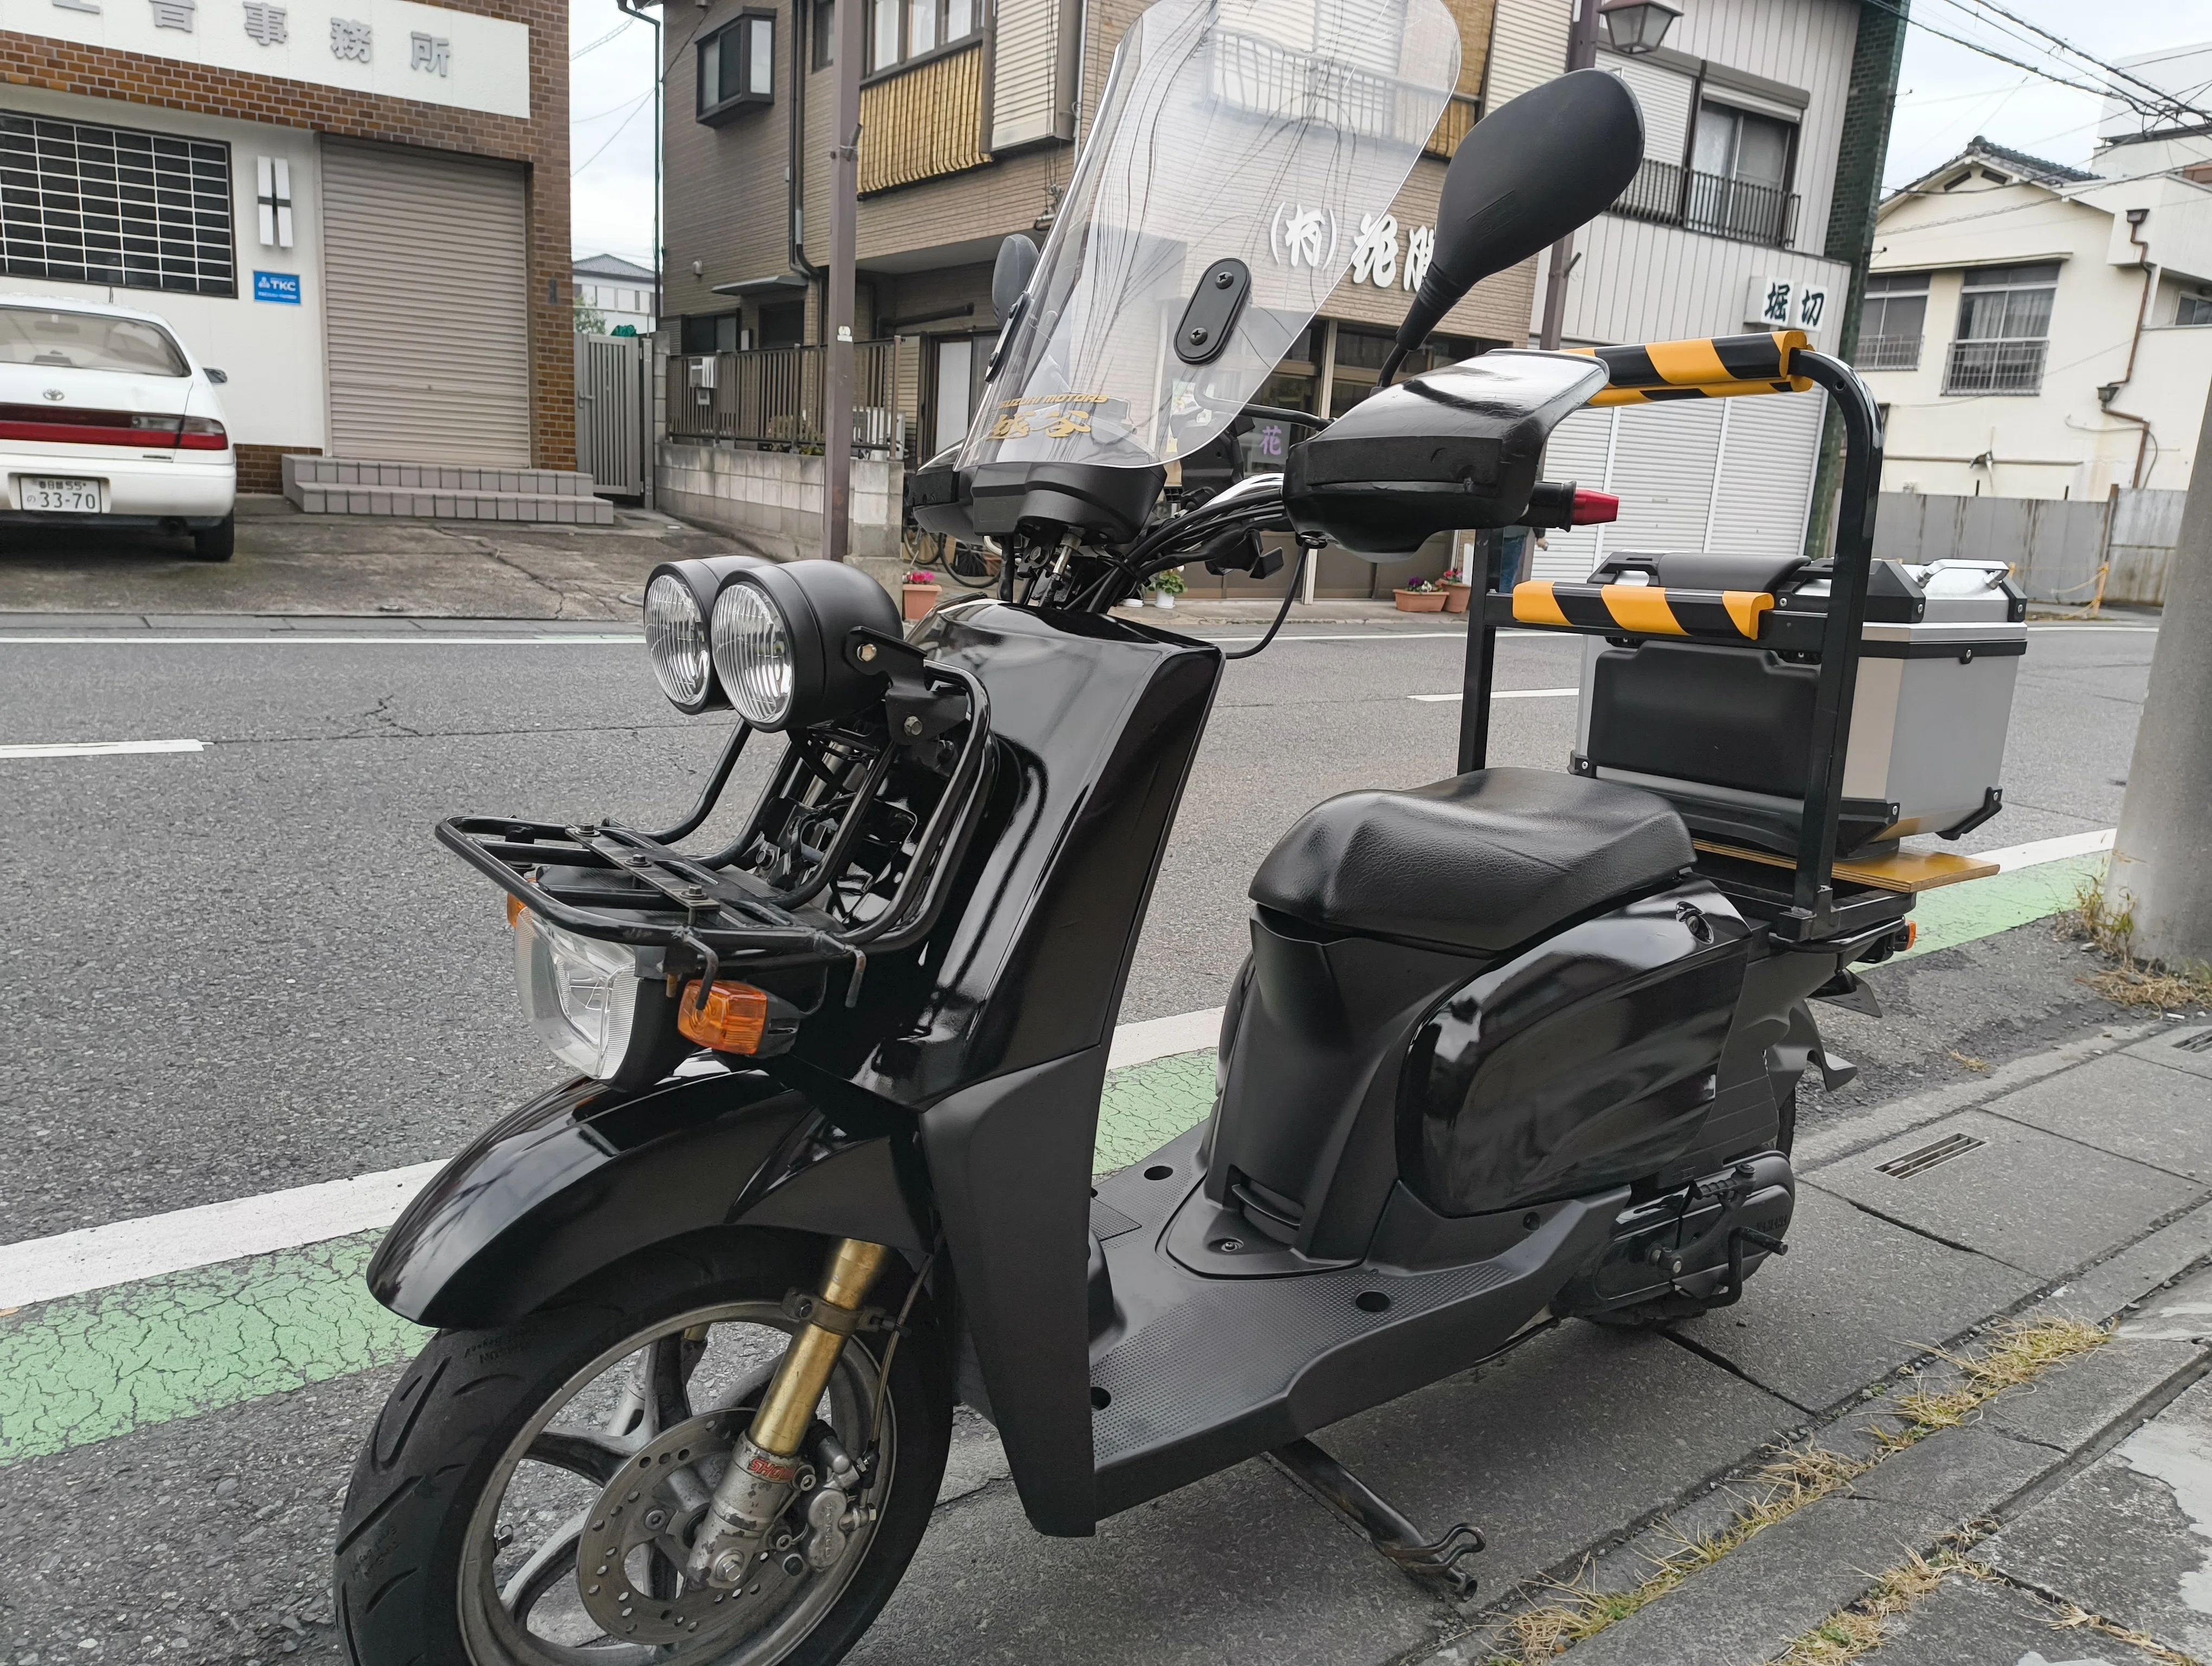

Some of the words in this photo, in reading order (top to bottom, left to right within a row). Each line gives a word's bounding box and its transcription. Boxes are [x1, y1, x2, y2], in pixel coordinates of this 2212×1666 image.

[270, 279, 296, 291] TKC
[1765, 282, 1824, 327] 堀切
[998, 396, 1042, 409] SUZUKI
[1043, 394, 1110, 404] MOTORS
[1259, 425, 1282, 455] 花
[40, 491, 95, 509] 33-70
[749, 1457, 796, 1480] SHO
